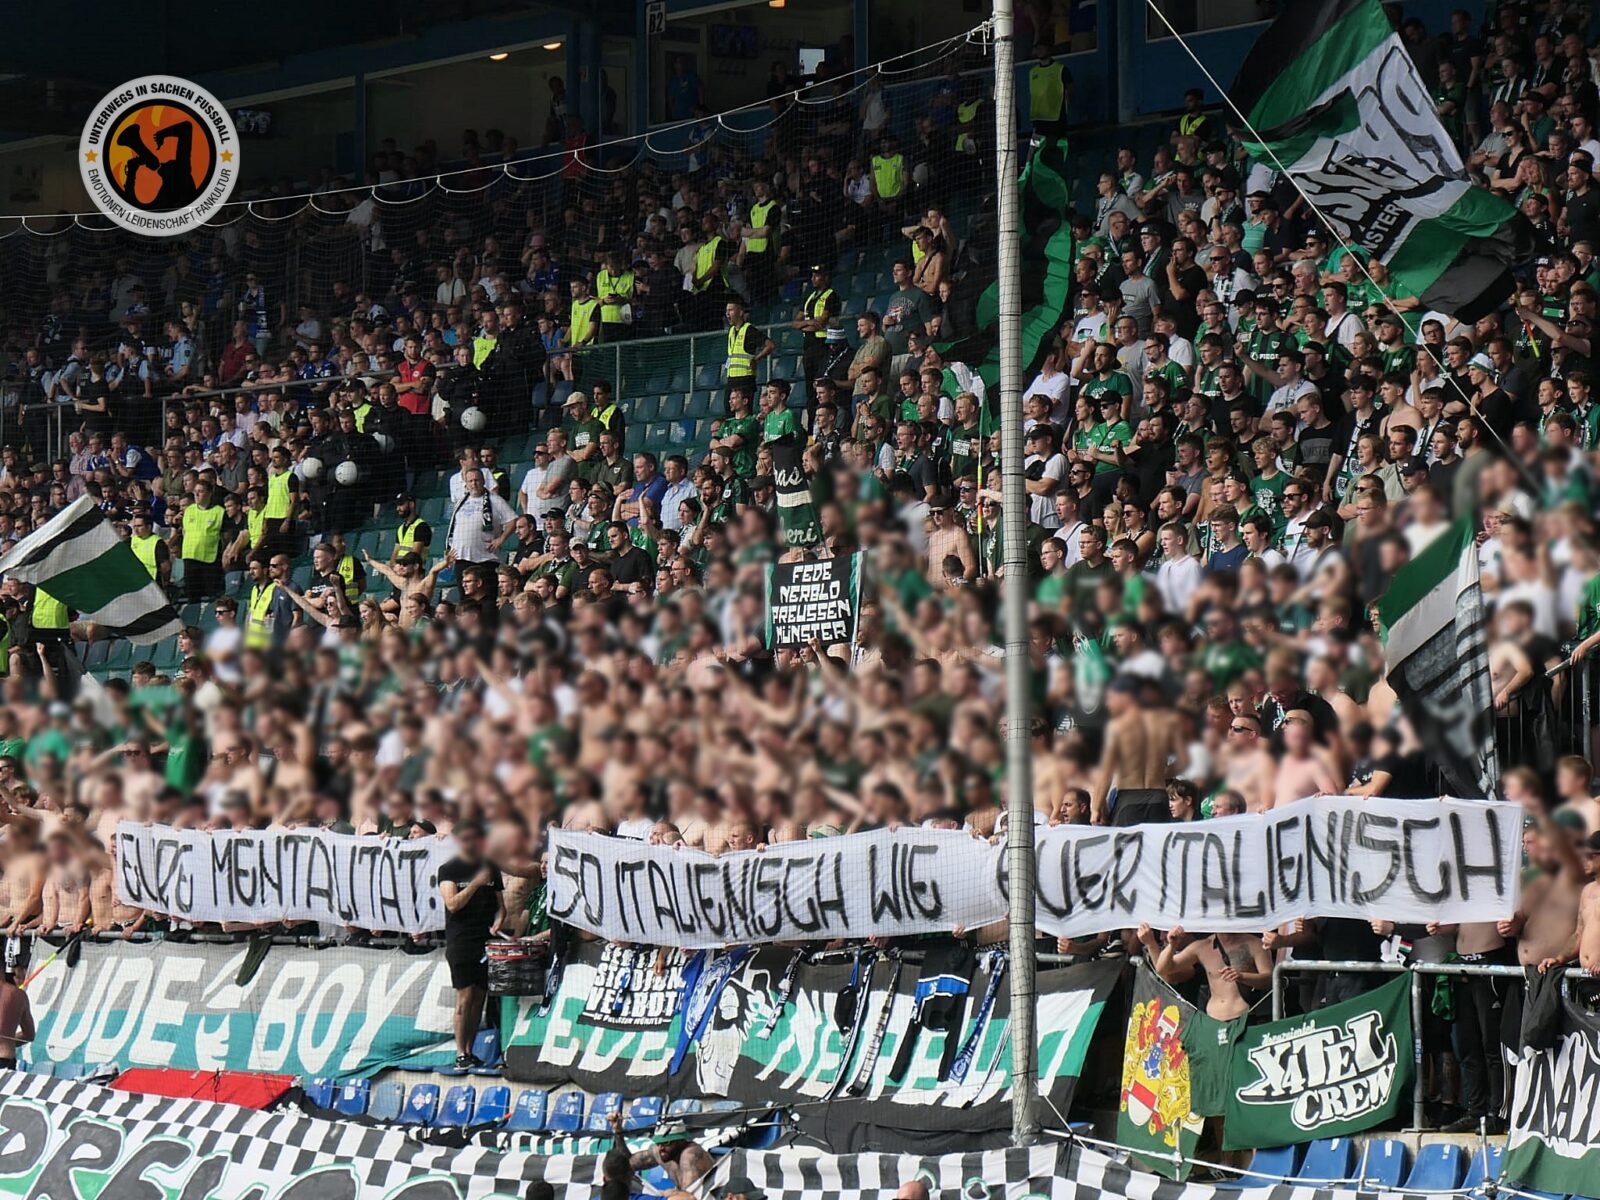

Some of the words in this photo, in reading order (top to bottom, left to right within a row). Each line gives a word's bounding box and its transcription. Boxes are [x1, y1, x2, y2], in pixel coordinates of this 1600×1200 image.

[649, 12, 663, 33] B2
[1361, 202, 1405, 255] NSTER
[780, 580, 841, 604] NERBLO
[792, 561, 832, 584] FEDE
[771, 599, 851, 624] PREUSSEN
[776, 620, 848, 645] MÜNSTER
[121, 832, 194, 913] EURE
[211, 833, 437, 926] MENTALITÄT:
[551, 844, 604, 927] SO
[614, 851, 849, 937] ITALIENISCH
[869, 842, 944, 921] WIE
[1159, 808, 1505, 918] ITALIENISCH
[23, 956, 206, 1065] RUDE
[1293, 1062, 1396, 1128] CREW
